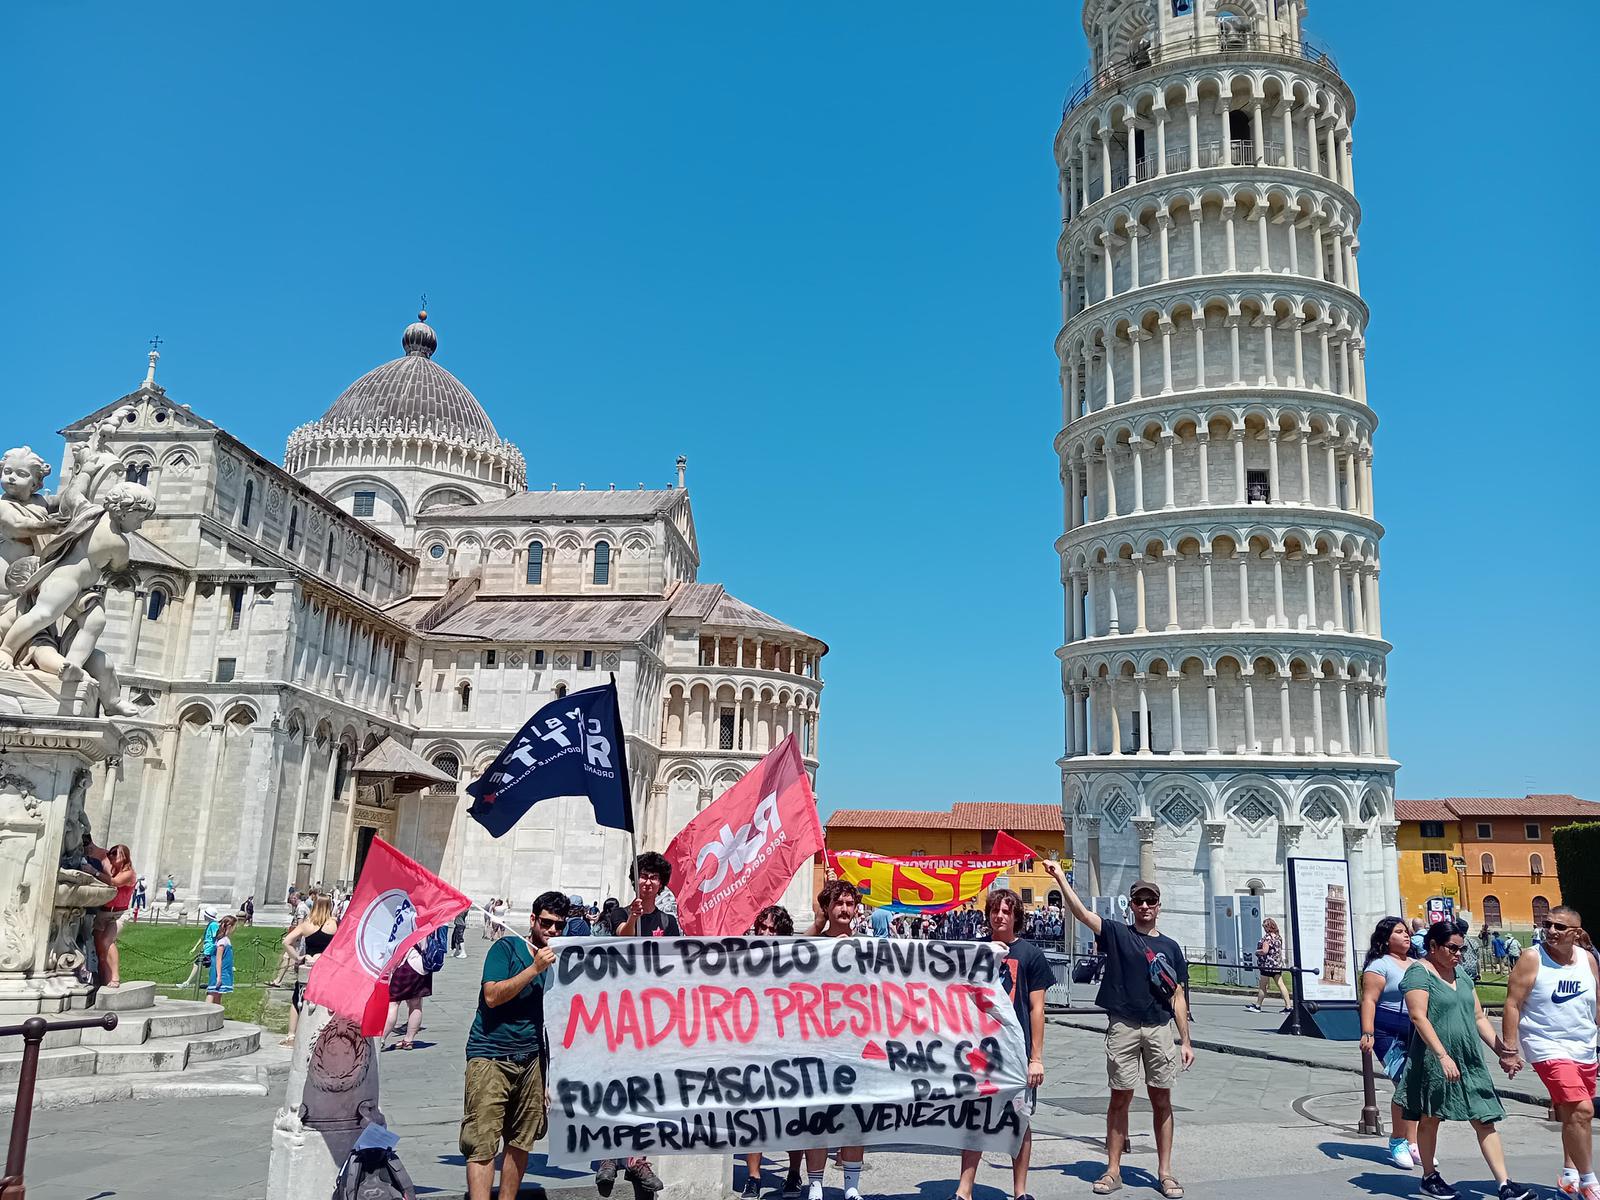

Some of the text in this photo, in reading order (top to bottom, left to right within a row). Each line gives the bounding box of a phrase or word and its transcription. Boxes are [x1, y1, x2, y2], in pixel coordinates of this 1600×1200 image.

[558, 938, 995, 985] CON IL POPOLO CHAVISTA
[1557, 980, 1581, 993] NIKE
[561, 980, 1001, 1052] MADURO PRESIDENTE
[556, 1057, 857, 1118] FUORI FASCISTI e
[567, 1107, 782, 1152] IMPERIALISTI
[851, 1097, 1020, 1137] VENEZUELA
